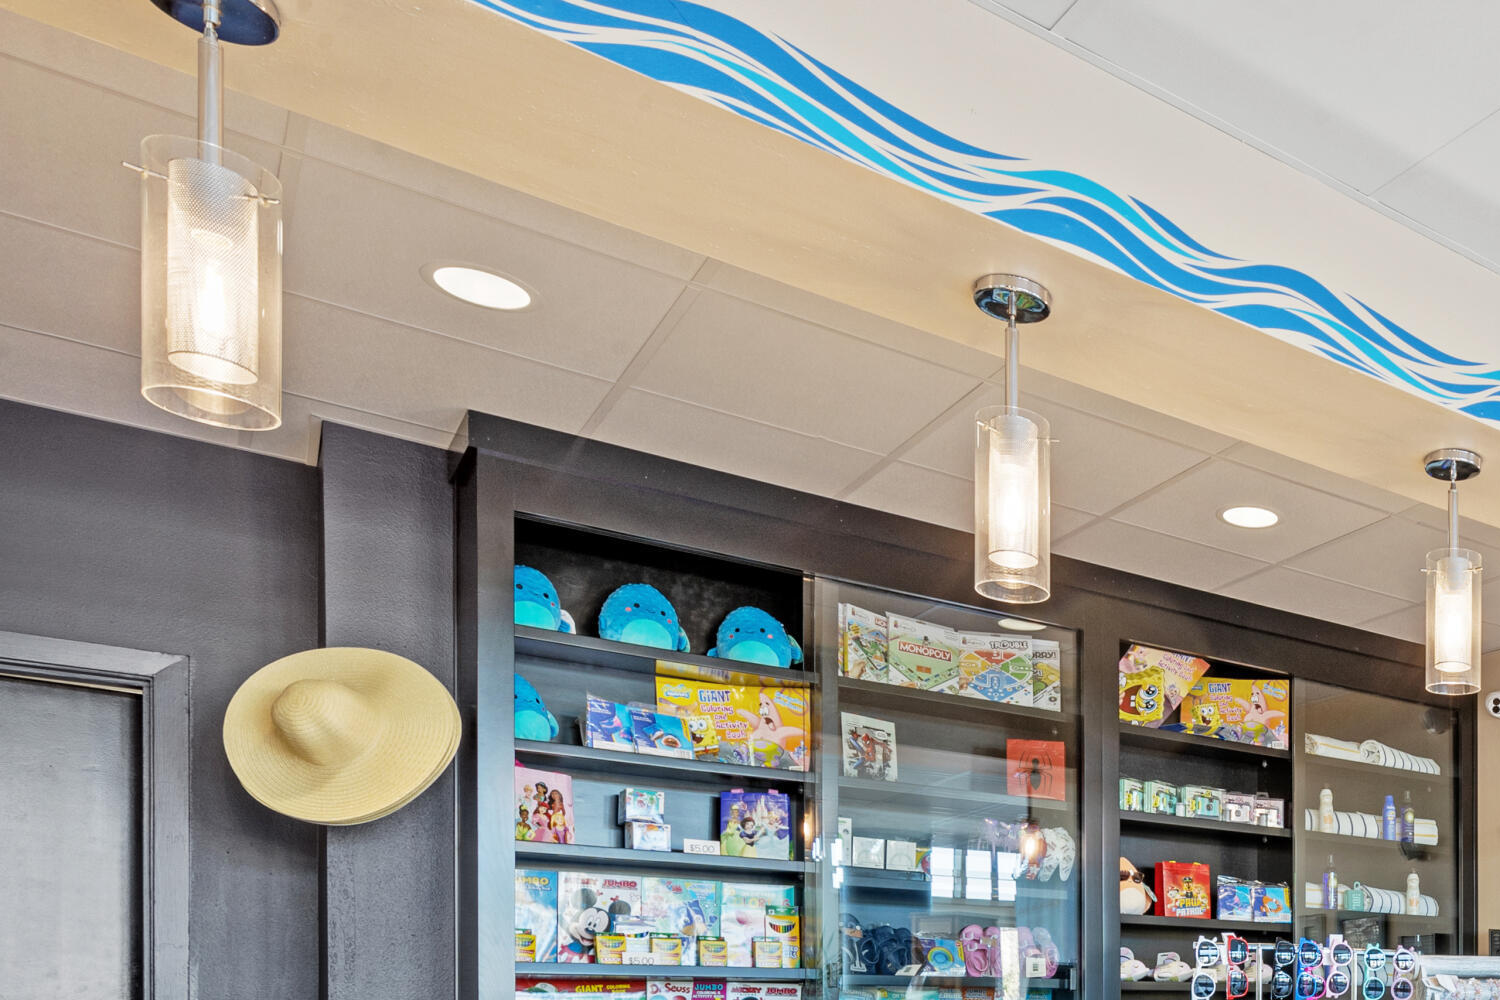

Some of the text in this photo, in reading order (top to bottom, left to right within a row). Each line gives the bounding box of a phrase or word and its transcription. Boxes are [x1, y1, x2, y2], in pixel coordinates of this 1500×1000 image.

[989, 640, 1028, 650] TROUBLE
[899, 641, 951, 661] MONOPOLY
[690, 843, 715, 854] $5.00
[1179, 898, 1201, 907] PAW
[1175, 907, 1205, 916] PATROL
[575, 985, 603, 993] GIANT
[665, 983, 690, 994] Seuss
